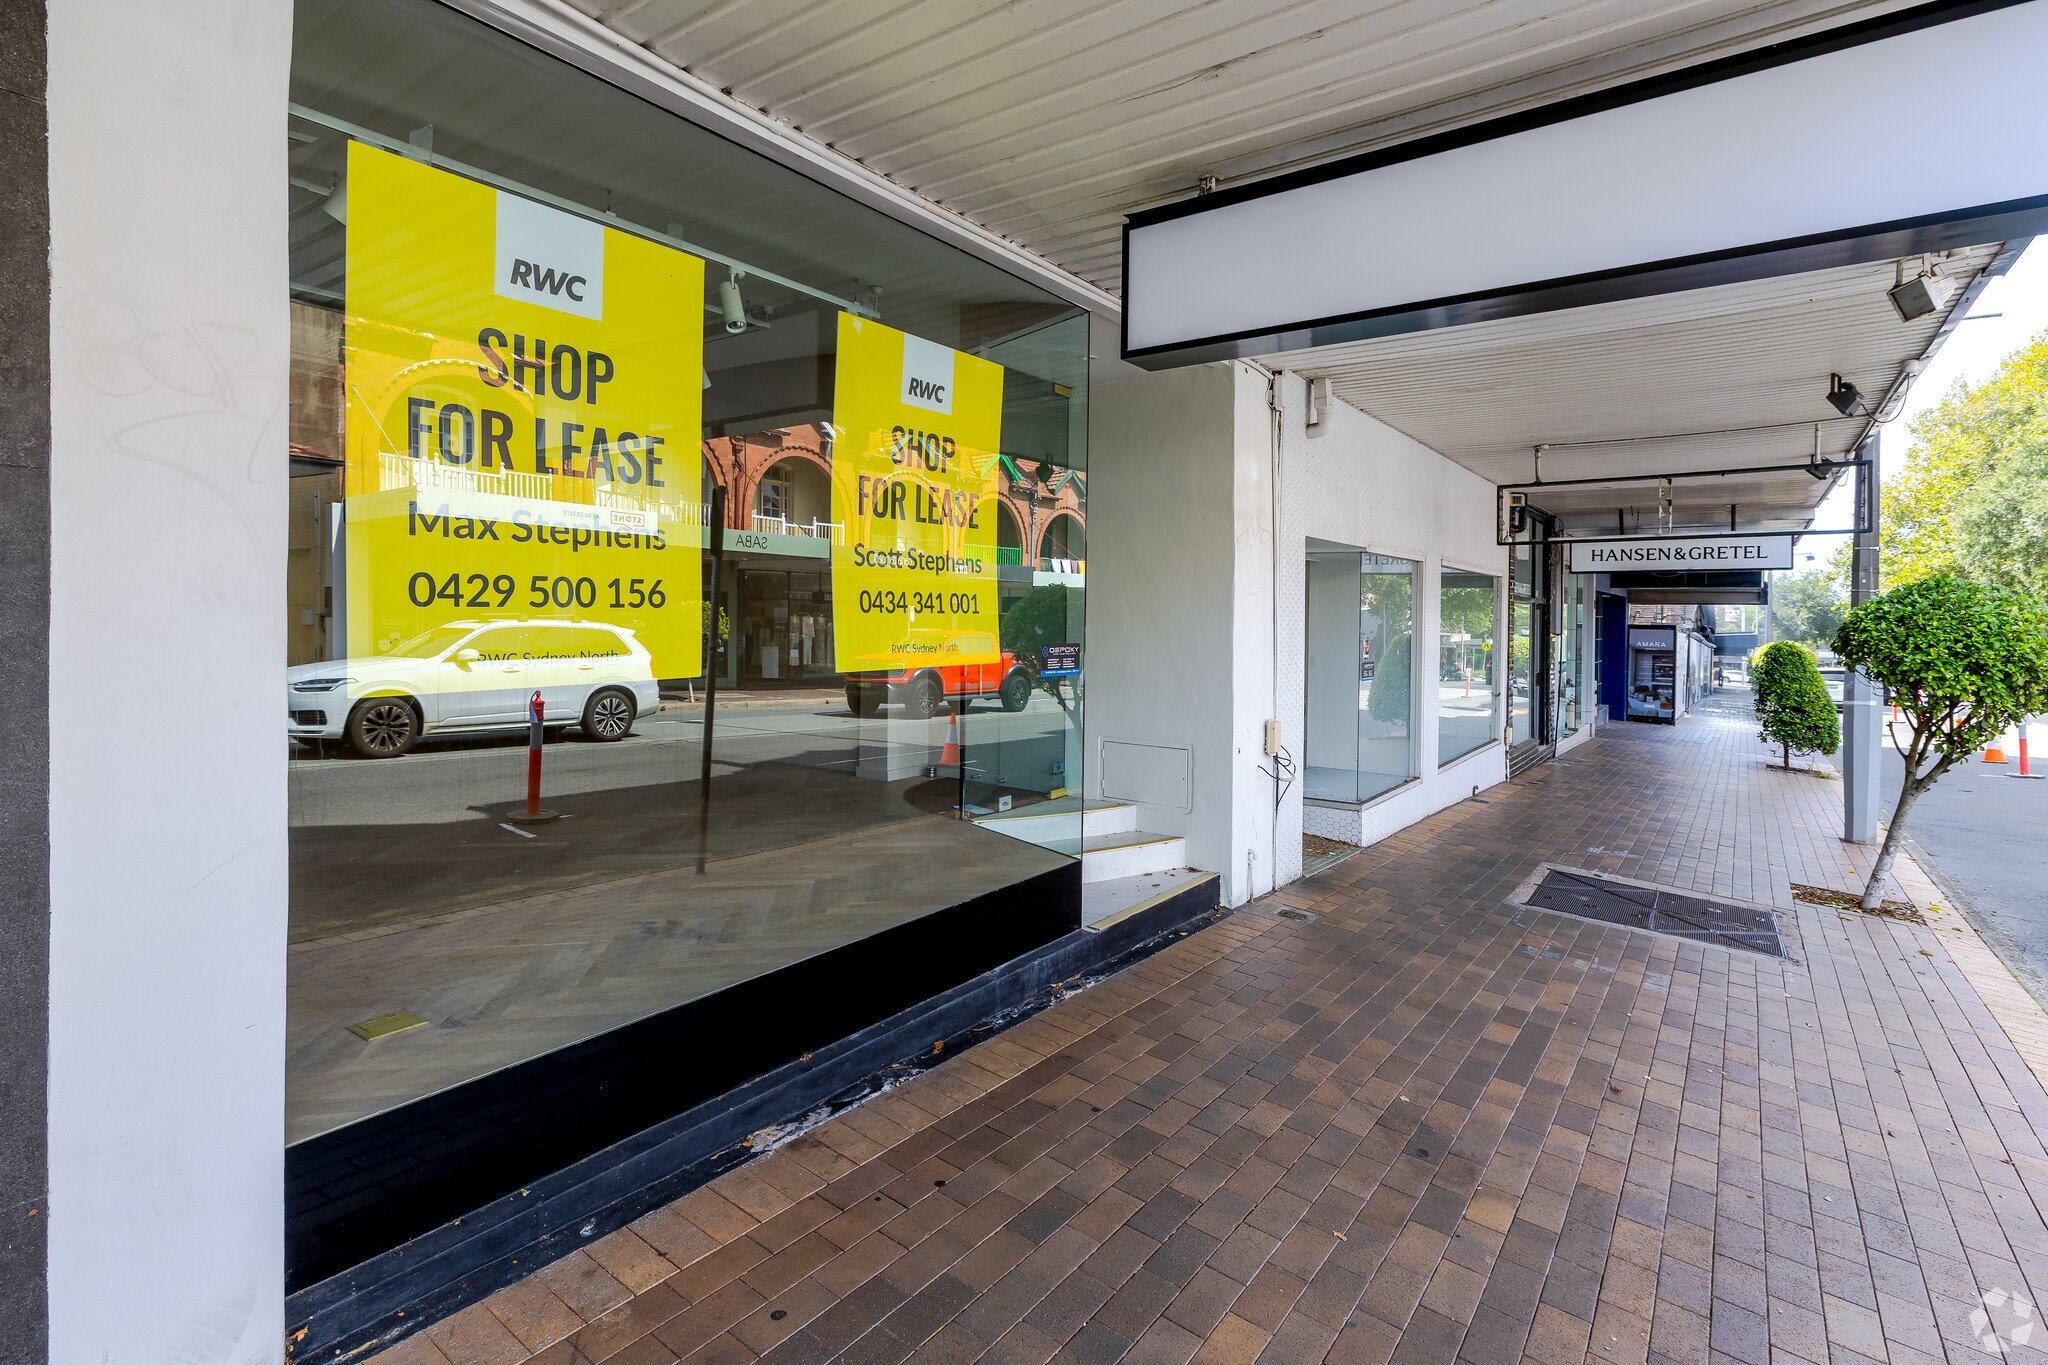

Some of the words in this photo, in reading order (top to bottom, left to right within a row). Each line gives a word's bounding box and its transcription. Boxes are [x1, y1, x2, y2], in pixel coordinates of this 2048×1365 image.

[510, 258, 587, 302] RWC
[477, 327, 614, 406] SHOP
[908, 377, 946, 404] RWC
[407, 397, 514, 471] FOR
[535, 418, 665, 488] LEASE
[891, 425, 956, 473] SHOP
[858, 475, 906, 521] FOR
[916, 484, 980, 529] LEASE
[408, 500, 500, 541] Max
[511, 507, 667, 552] Stephens
[853, 542, 903, 569] Scott
[907, 547, 982, 576] Stephens
[1590, 545, 1768, 562] HANSEN&GRETEL
[407, 571, 516, 609] 0429
[529, 575, 596, 609] 500
[606, 578, 666, 609] 156
[859, 590, 908, 614] 0434
[913, 592, 945, 614] 341
[949, 593, 980, 614] 001
[477, 653, 518, 667] RWC
[523, 651, 576, 668] Sydney
[579, 650, 619, 663] North
[891, 643, 911, 654] RWC
[912, 643, 938, 654] Sydney
[939, 642, 959, 652] North
